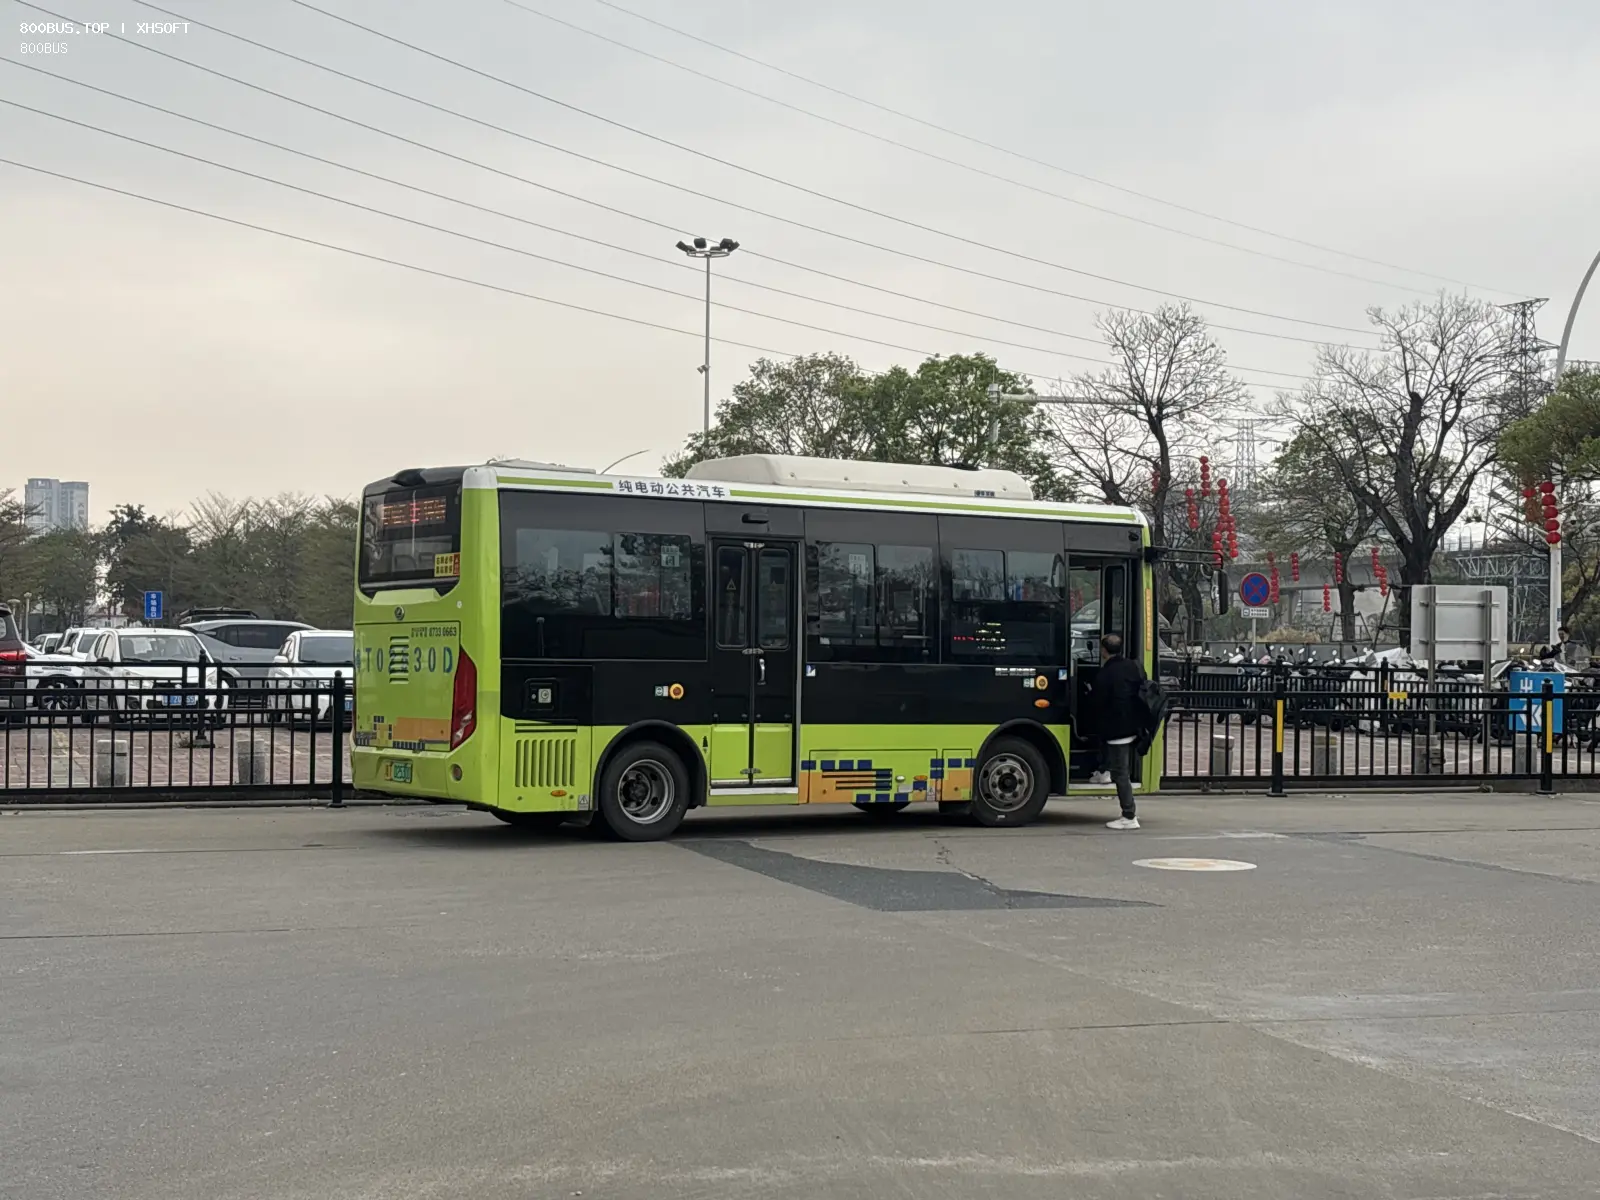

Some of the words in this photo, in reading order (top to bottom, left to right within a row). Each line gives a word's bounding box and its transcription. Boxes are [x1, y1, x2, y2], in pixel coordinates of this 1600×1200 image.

[618, 479, 726, 498] 纯电动公共汽车
